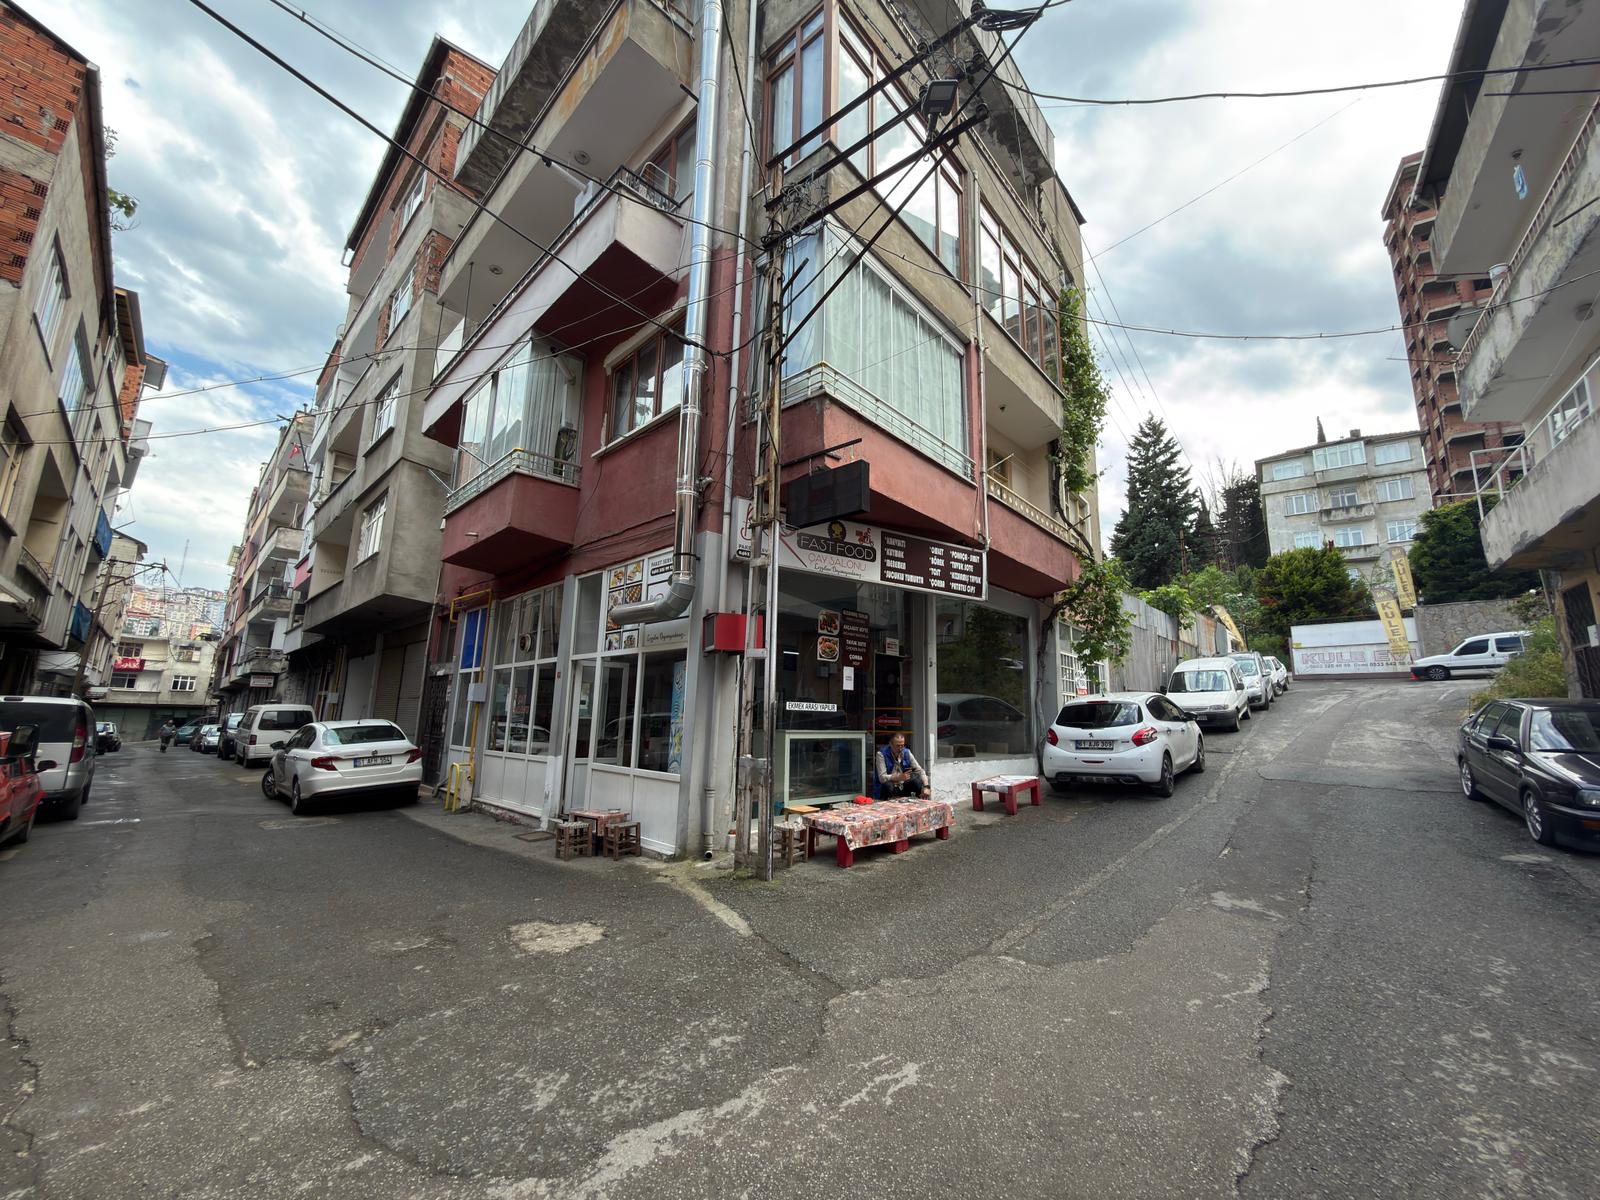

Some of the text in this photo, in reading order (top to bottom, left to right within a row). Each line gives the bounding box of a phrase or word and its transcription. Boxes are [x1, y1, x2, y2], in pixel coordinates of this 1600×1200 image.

[800, 536, 875, 560] FAST FOOD
[808, 552, 867, 571] ÇAY SALONU
[1395, 559, 1409, 591] KULE
[1381, 601, 1402, 637] KULE
[1301, 651, 1365, 664] KULE
[788, 702, 835, 711] EKMEK ARASI YAPILIR
